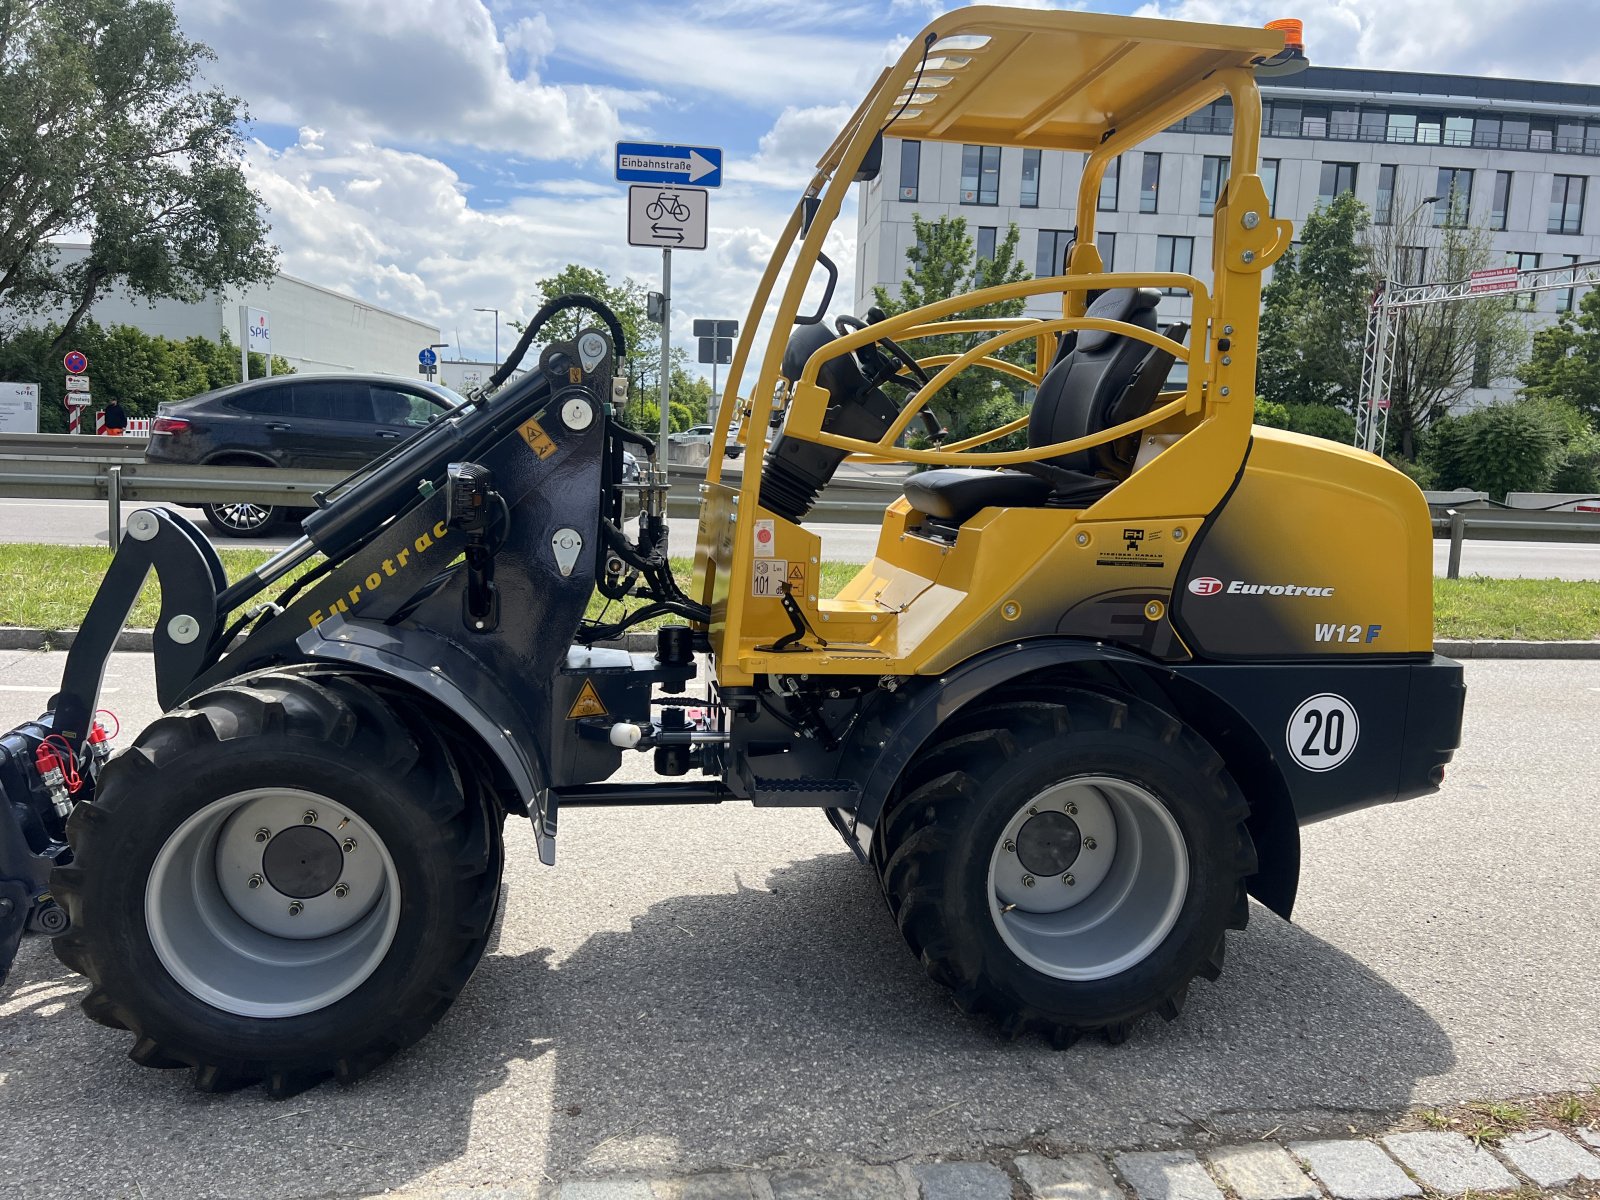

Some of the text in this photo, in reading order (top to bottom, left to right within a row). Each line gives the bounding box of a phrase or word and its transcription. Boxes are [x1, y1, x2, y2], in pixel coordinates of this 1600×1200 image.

[622, 157, 692, 171] Einbahnstraße
[250, 325, 270, 340] SPIE
[1124, 530, 1143, 539] FH
[308, 520, 448, 629] Eurotrac
[755, 576, 769, 594] 101
[1227, 581, 1335, 597] Eurotrac
[1301, 708, 1344, 756] 20
